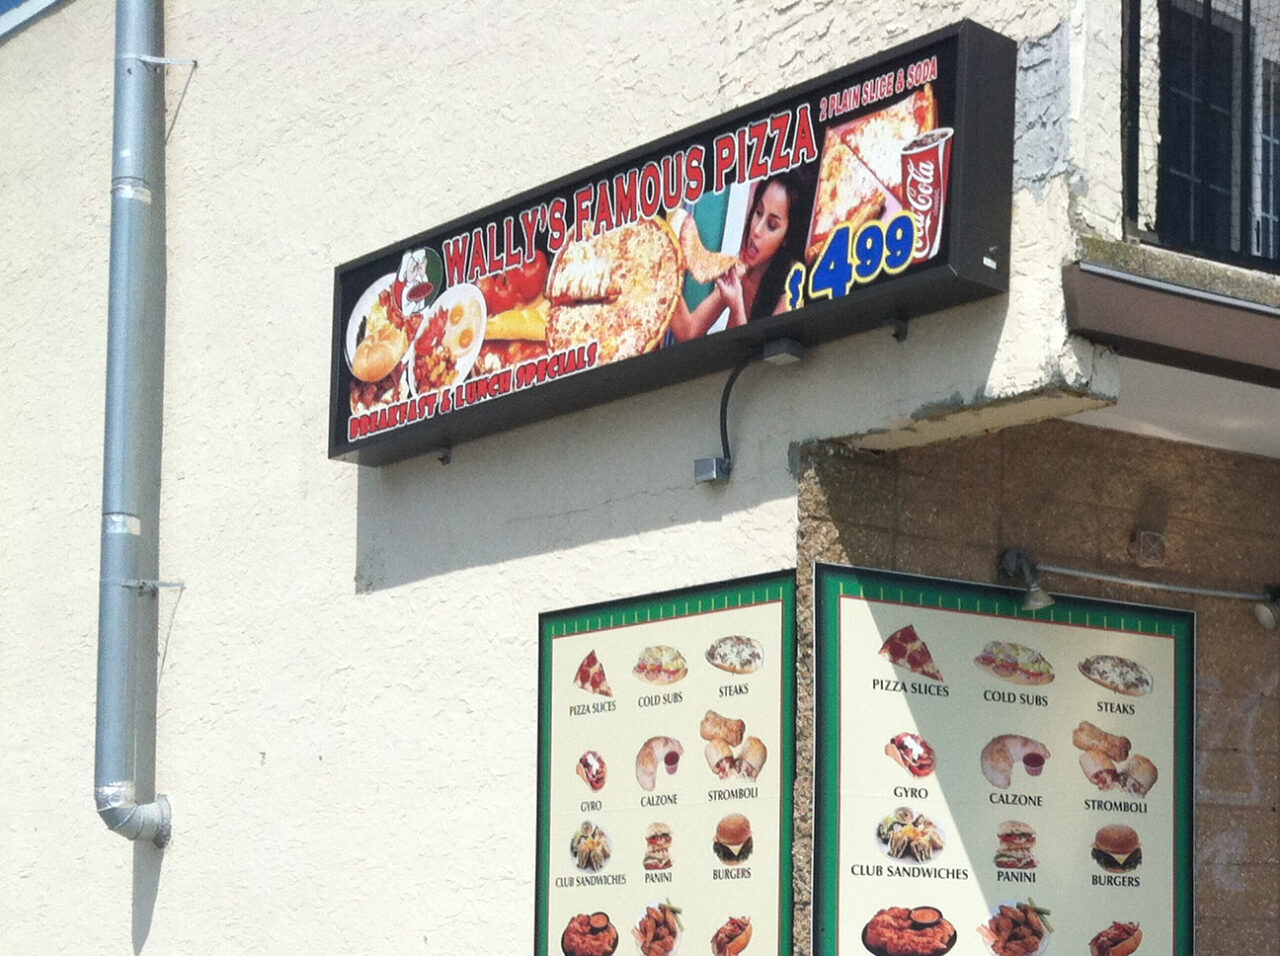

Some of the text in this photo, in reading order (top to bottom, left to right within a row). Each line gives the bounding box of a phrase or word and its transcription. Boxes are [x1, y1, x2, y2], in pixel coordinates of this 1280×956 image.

[819, 55, 938, 122] 2 PLAIN SLICE & SODA
[443, 103, 818, 286] WALLY'S FAMOUS PIZZA
[348, 389, 438, 442] BREAKFAST
[454, 368, 513, 410] LUNCH
[514, 339, 599, 389] SPECIALS
[718, 683, 749, 698] STEAKS
[872, 678, 949, 697] PIZZA SLICES
[637, 692, 683, 708] COLD SUBS
[983, 689, 1049, 707] COLD SUBS
[569, 700, 617, 717] PIZZA SLICES
[1096, 701, 1136, 716] STEAKS
[707, 787, 759, 802] STROMBOLI
[893, 786, 929, 800] GYRO
[989, 792, 1043, 807] CALZONE
[580, 800, 602, 813] GYRO
[640, 794, 678, 808] CALZONE
[1084, 799, 1148, 814] STROMBOLI
[644, 872, 672, 884] PANINI
[712, 867, 751, 881] BURGERS
[850, 864, 969, 880] CLUB SANDWICHES
[996, 870, 1036, 884] PANINI
[555, 873, 627, 888] CLUB SANDWICHES
[1091, 874, 1141, 888] BURGERS
